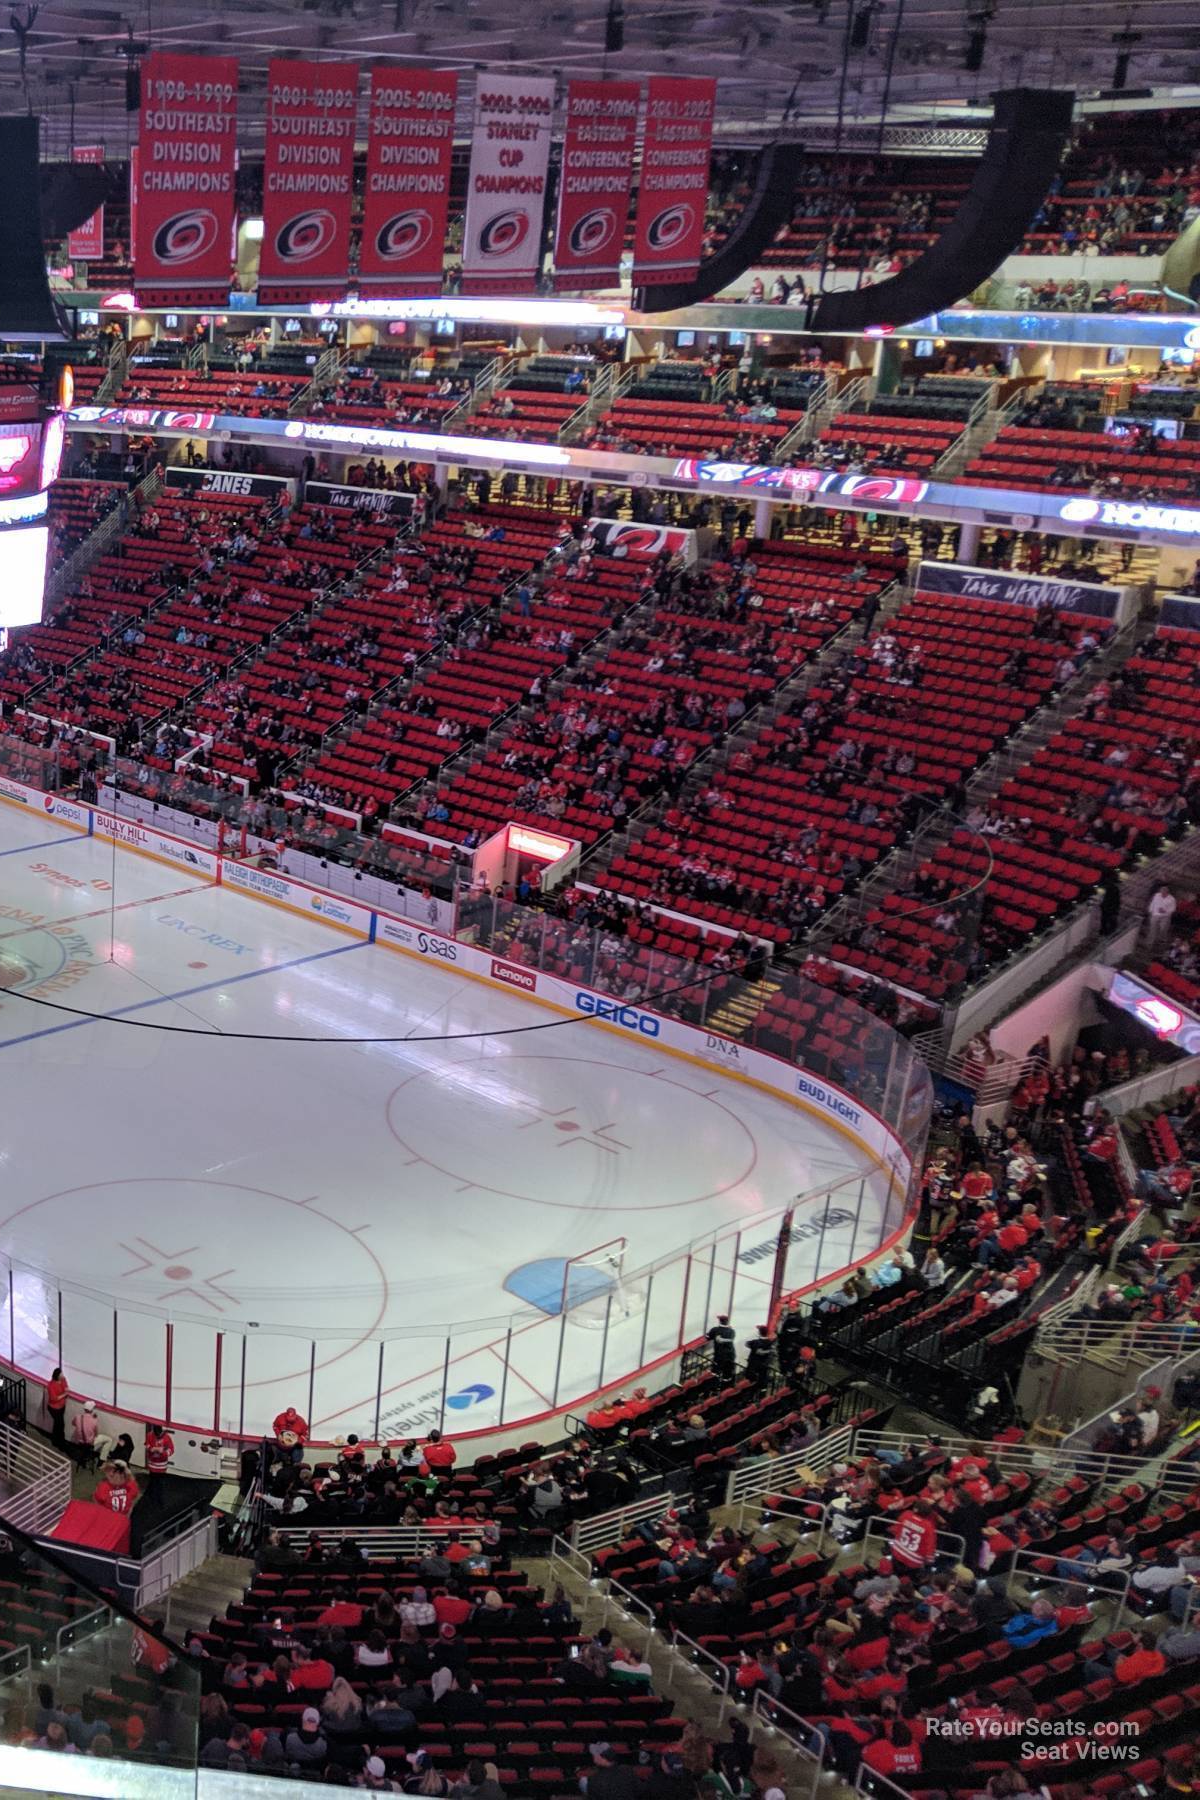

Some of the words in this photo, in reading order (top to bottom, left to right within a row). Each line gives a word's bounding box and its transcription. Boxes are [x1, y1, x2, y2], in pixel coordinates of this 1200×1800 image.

[146, 80, 233, 103] 1998-1999
[273, 85, 354, 107] 2001-2002
[375, 88, 452, 111] 2005-2006
[145, 110, 232, 133] SOUTHEAST
[271, 117, 351, 137] SOUTHEAST
[373, 117, 449, 137] SOUTHEAST
[487, 120, 540, 141] STANLEY
[577, 125, 628, 142] EASTERN
[656, 123, 702, 142] EASTERN
[153, 142, 221, 163] DIVISION
[278, 144, 341, 164] DIVISION
[380, 145, 440, 165] DIVISION
[499, 149, 524, 168] CUP
[567, 151, 632, 168] CONFERENCE
[646, 150, 707, 167] CONFERENCE
[143, 172, 231, 192] CHAMPIONS
[268, 173, 349, 193] CHAMPIONS
[370, 173, 445, 193] CHAMPIONS
[475, 175, 544, 194] CHAMPIONS
[566, 176, 629, 193] CHAMPIONS
[644, 173, 705, 190] CHAMPIONS
[201, 474, 253, 495] CANES
[329, 490, 350, 505] TAKE
[353, 491, 394, 511] WARNING
[962, 575, 999, 597] TAKE
[1004, 580, 1088, 608] WARNING
[56, 803, 82, 820] pepsi
[97, 815, 126, 834] BULLY
[127, 826, 150, 843] HILL
[105, 829, 140, 846] VINEYARDS
[159, 842, 184, 860] Michael
[224, 861, 249, 879] RALEIGH
[323, 904, 352, 923] Lottery
[493, 963, 533, 987] Lenovo
[575, 992, 660, 1037] GEICO
[706, 1035, 740, 1058] DNA
[798, 1078, 825, 1102] BUD
[827, 1094, 862, 1126] LIGHT
[900, 1526, 921, 1552] 53
